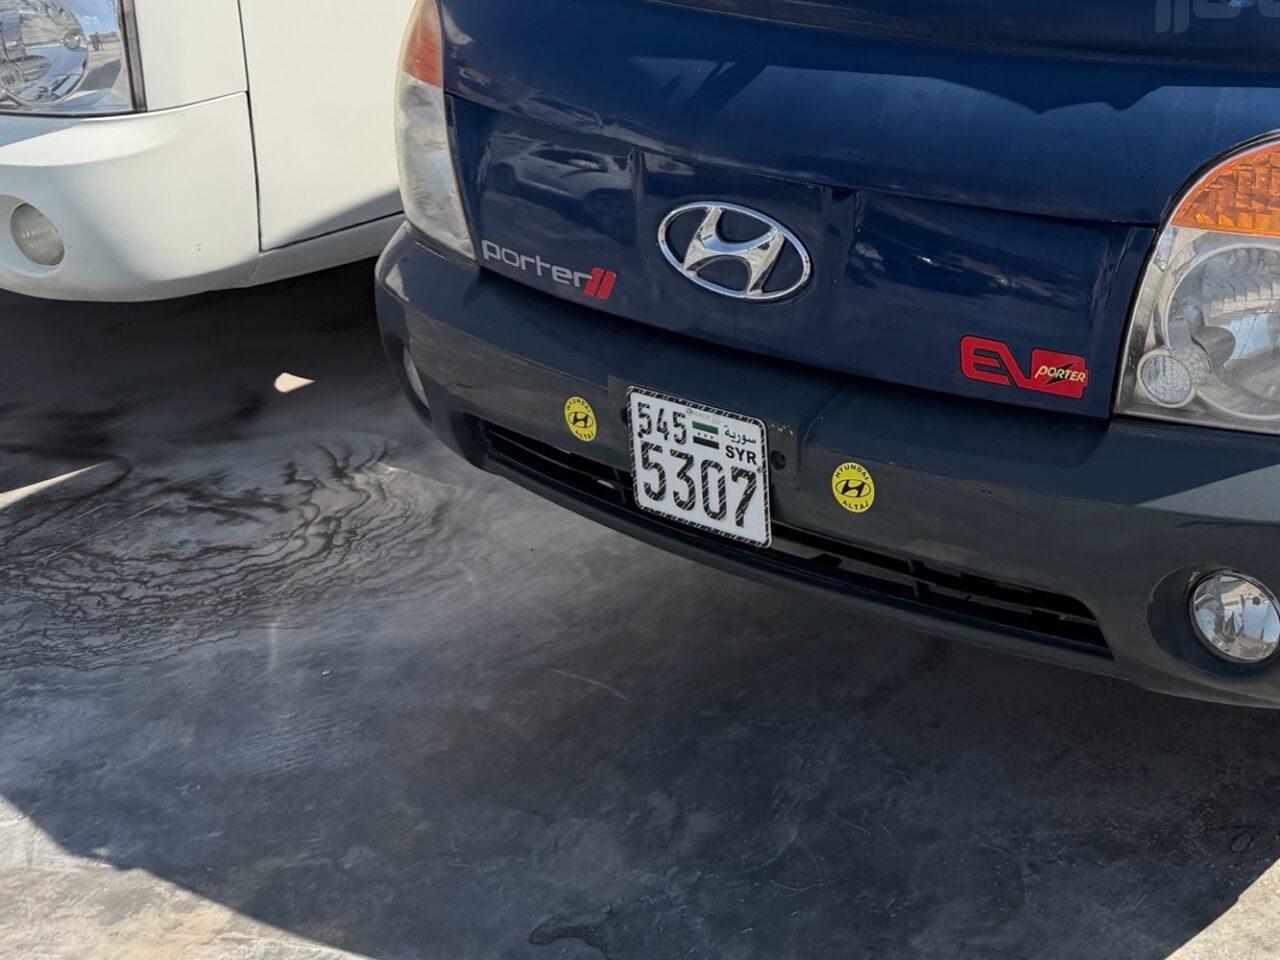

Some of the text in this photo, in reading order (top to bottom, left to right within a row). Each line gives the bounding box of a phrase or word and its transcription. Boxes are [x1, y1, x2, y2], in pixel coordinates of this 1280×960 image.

[1034, 365, 1087, 383] PORTER
[637, 401, 688, 445] 545
[723, 424, 757, 445] سورية
[725, 444, 757, 466] SYR
[835, 464, 870, 481] HYUNDAI
[640, 439, 757, 529] 5307
[842, 499, 869, 511] ALTAJ
